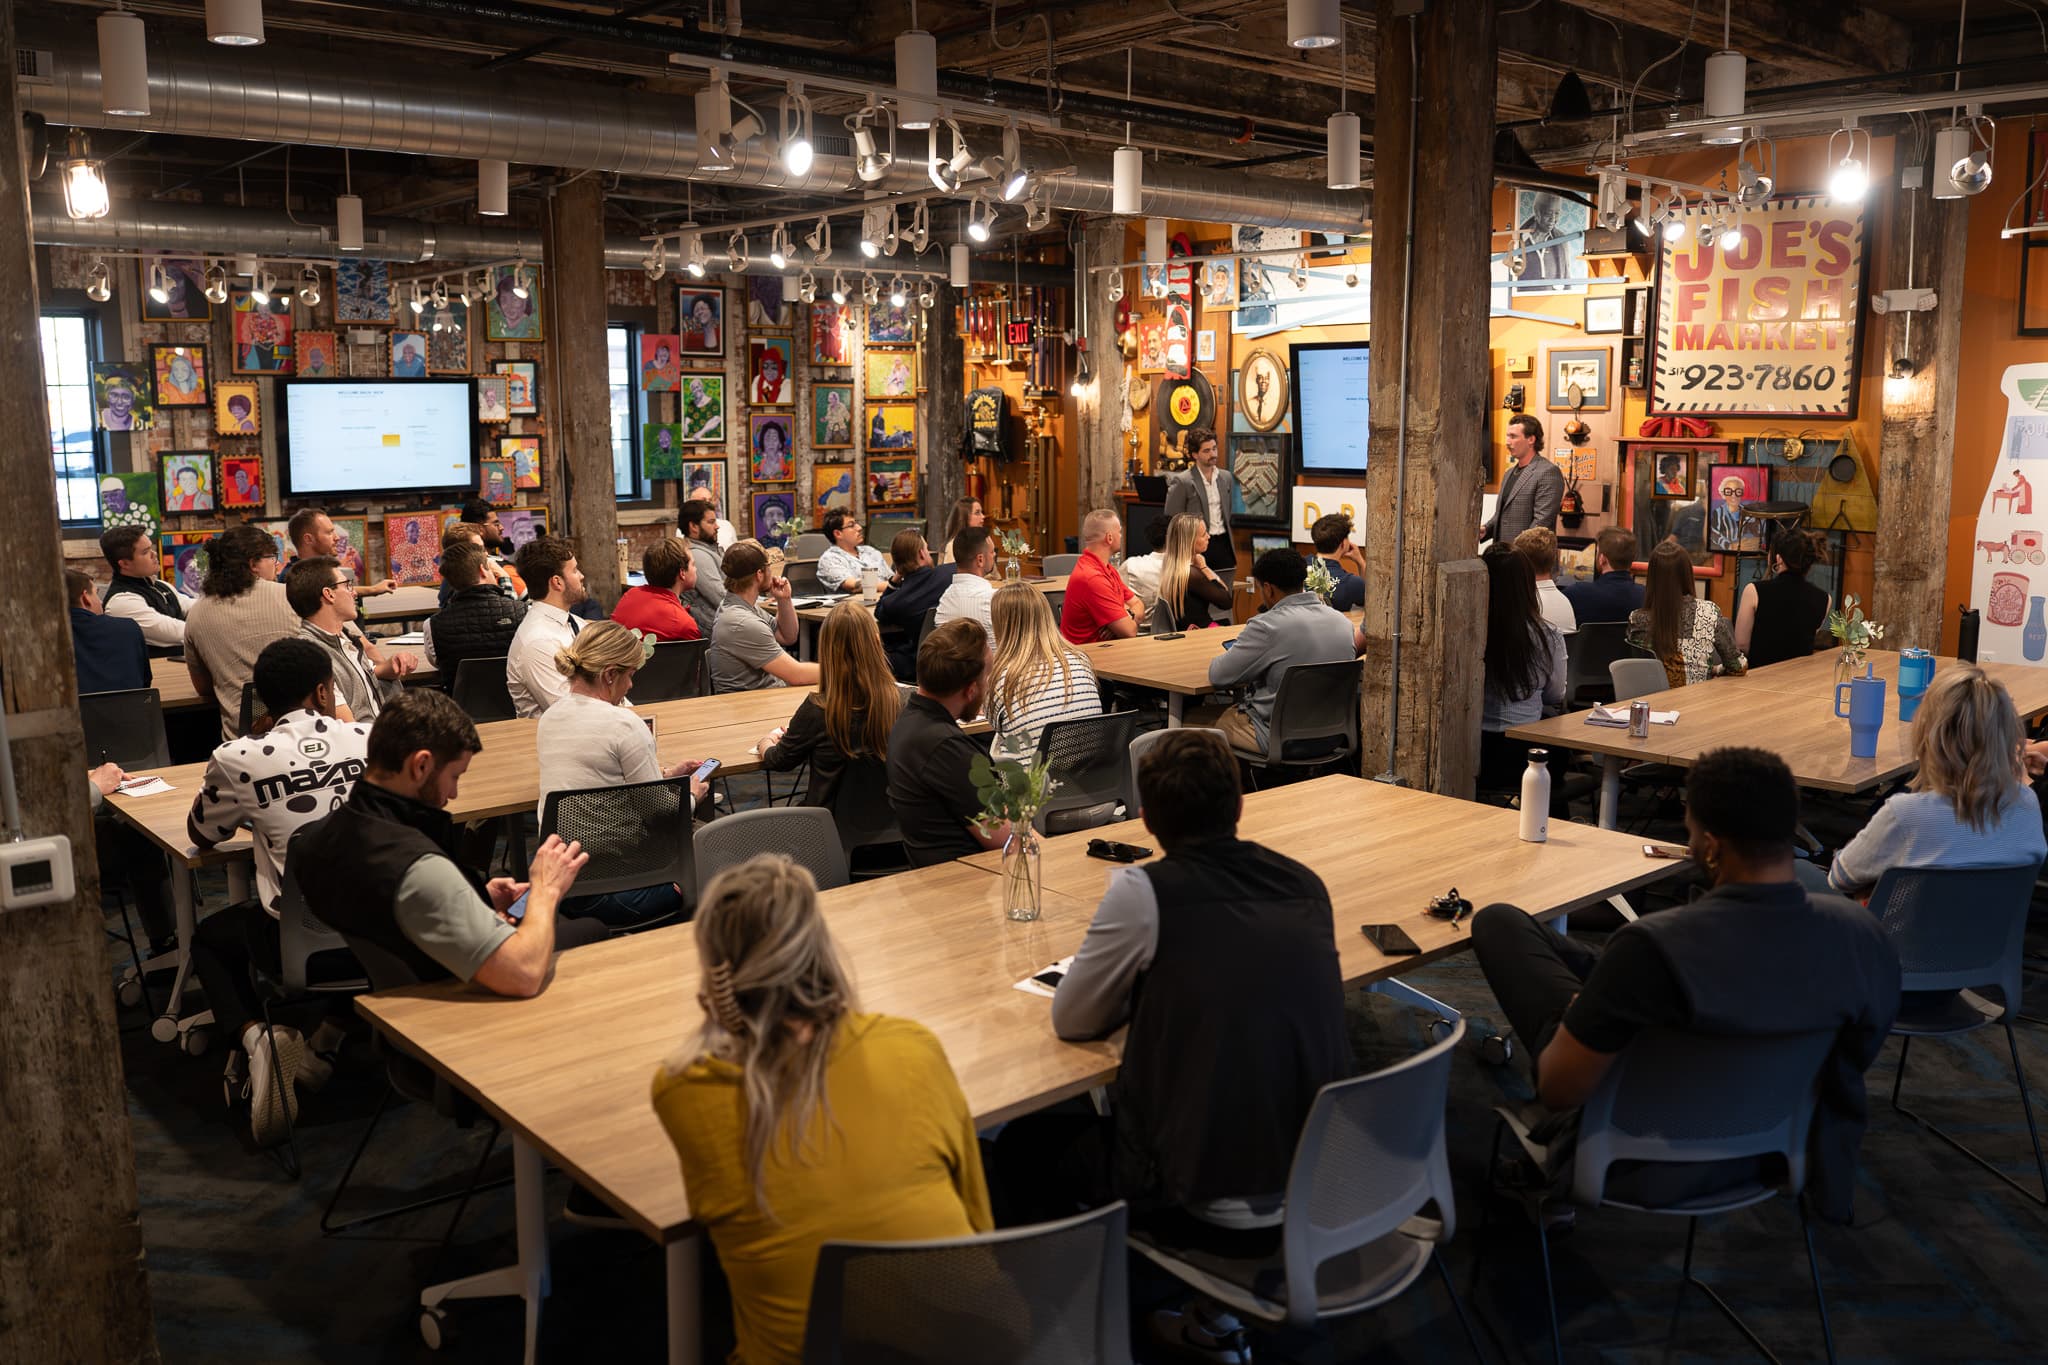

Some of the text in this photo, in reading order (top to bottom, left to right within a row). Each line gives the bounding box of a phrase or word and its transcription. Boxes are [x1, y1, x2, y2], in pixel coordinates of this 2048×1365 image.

[1674, 220, 1854, 281] JOE'S
[1675, 276, 1844, 322] FISH
[1008, 323, 1029, 343] EXIT
[1672, 320, 1846, 351] MARKET
